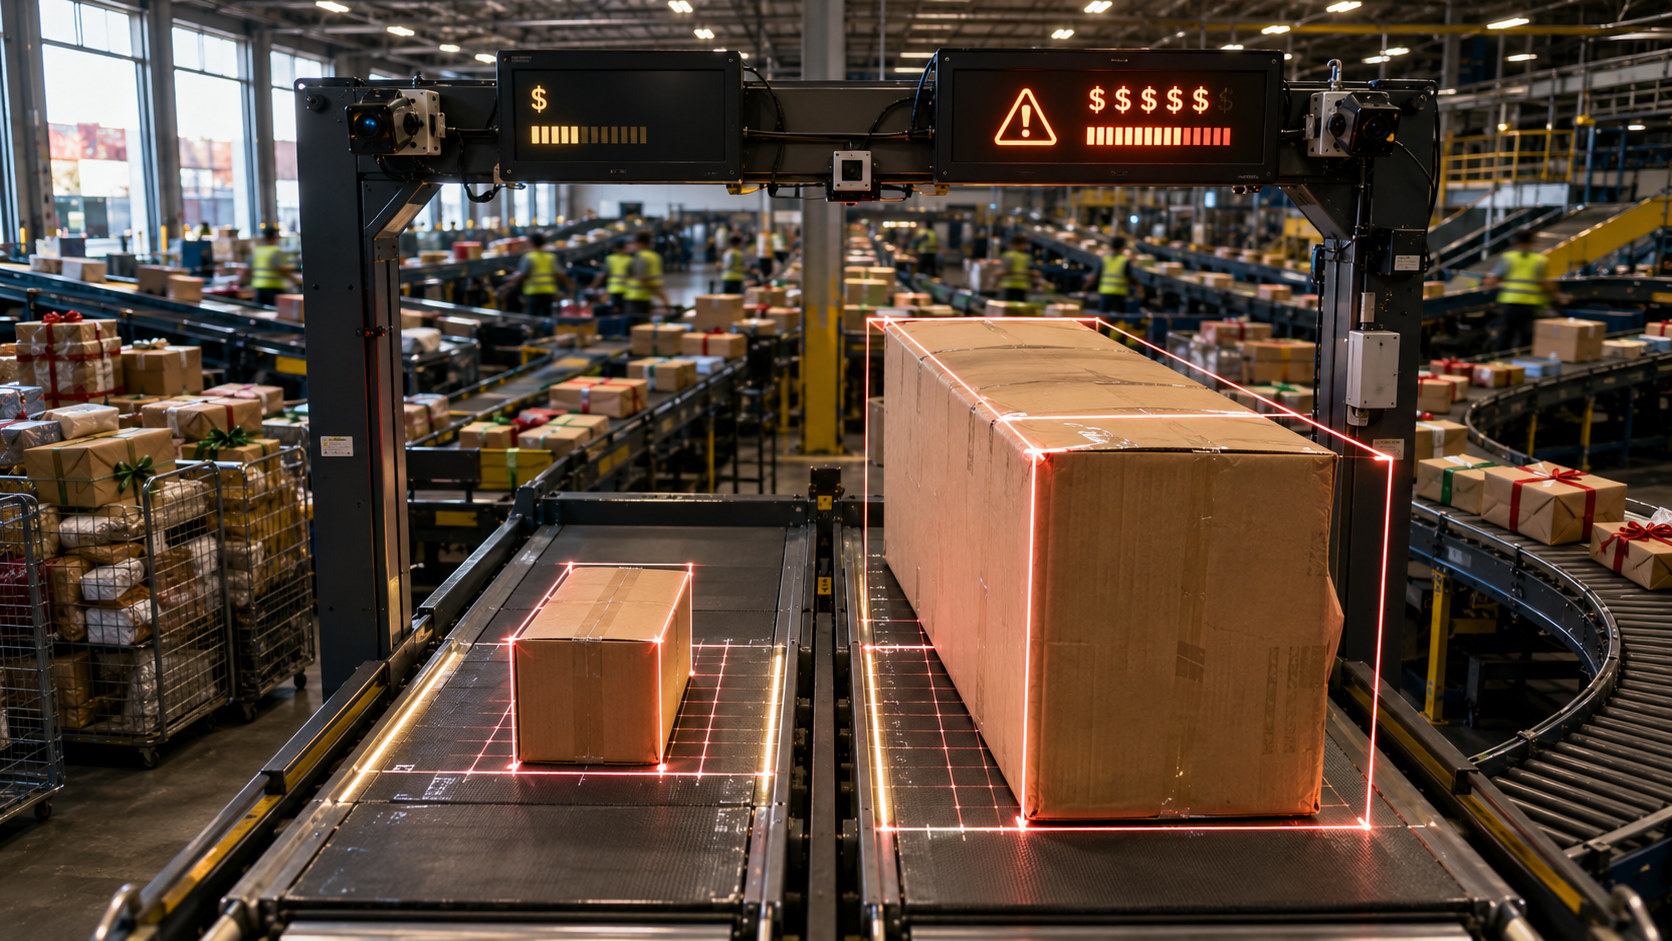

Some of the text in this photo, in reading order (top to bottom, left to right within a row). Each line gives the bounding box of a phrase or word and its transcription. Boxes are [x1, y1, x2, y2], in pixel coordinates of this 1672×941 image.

[531, 85, 548, 113] $
[1088, 85, 1106, 115] $
[1114, 85, 1132, 115] $
[1140, 85, 1158, 115] $
[1166, 85, 1184, 115] $
[1192, 85, 1209, 115] $
